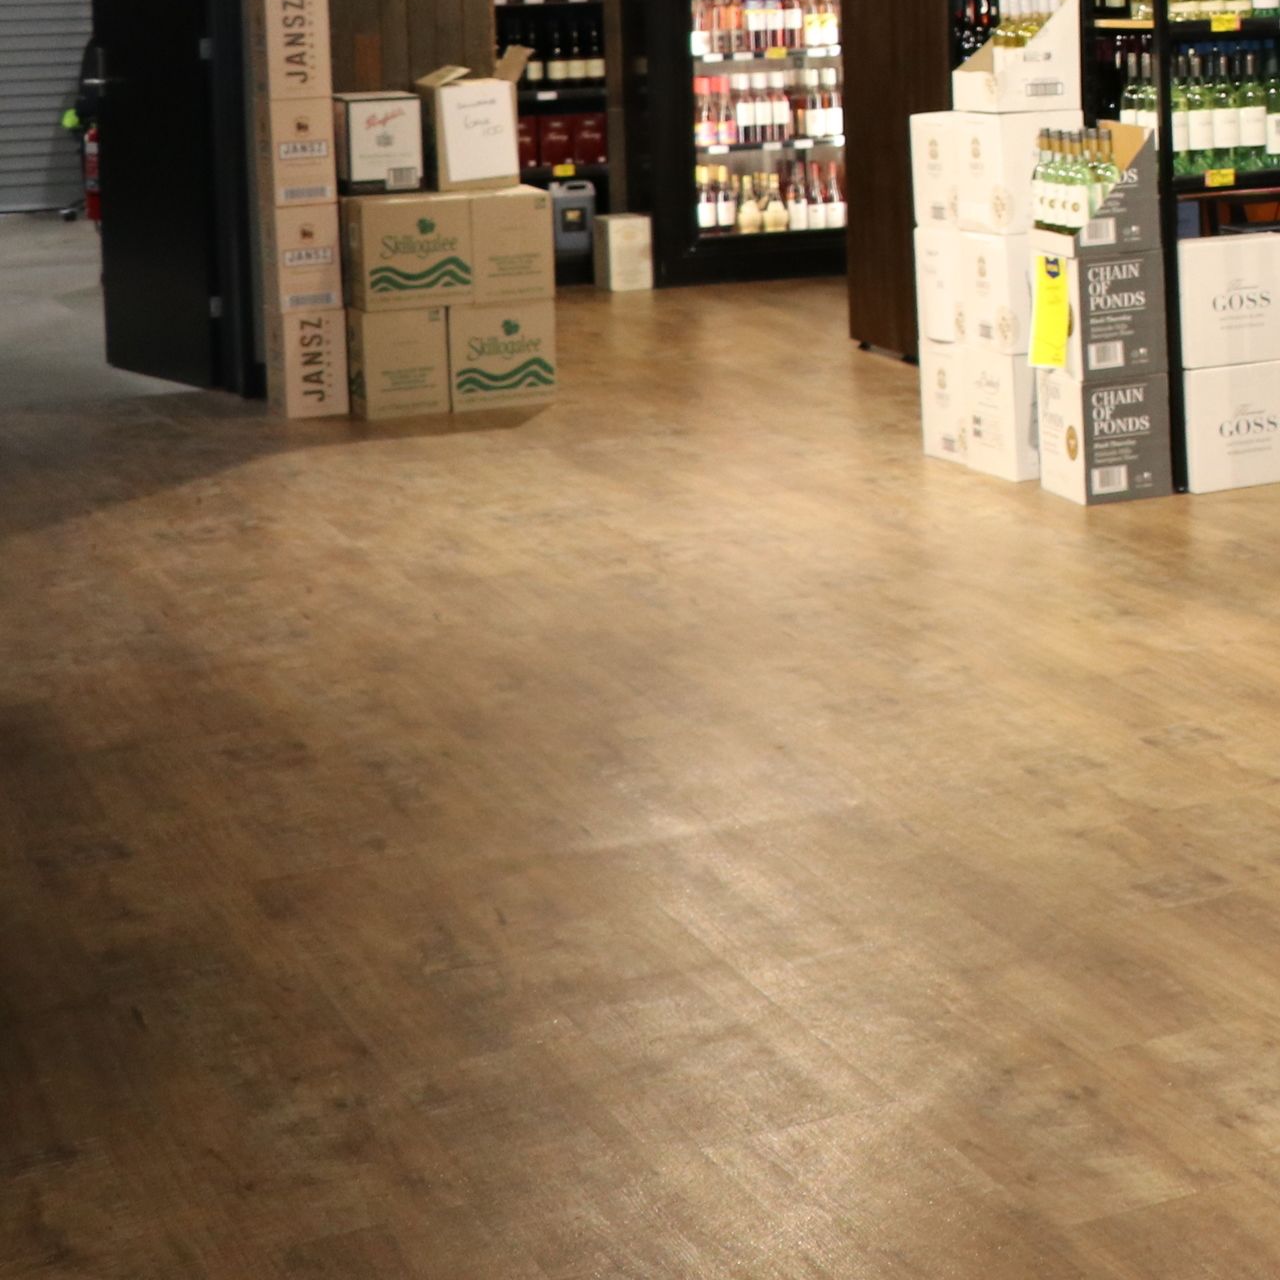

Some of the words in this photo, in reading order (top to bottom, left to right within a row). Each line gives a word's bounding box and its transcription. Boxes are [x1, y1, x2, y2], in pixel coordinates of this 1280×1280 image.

[283, 141, 325, 155] JANSZ
[287, 248, 331, 263] JANSZ
[380, 235, 458, 260] Skillogalee
[1088, 263, 1140, 283] CHAIN
[1088, 280, 1110, 296] OF
[1090, 291, 1146, 311] PONDS
[1212, 291, 1272, 312] GOSS
[466, 336, 542, 361] Skillogalee
[300, 317, 325, 402] JANSZ
[1091, 387, 1144, 407] CHAIN
[1092, 405, 1115, 421] OF
[1093, 415, 1150, 436] PONDS
[1219, 416, 1279, 439] GOSS
